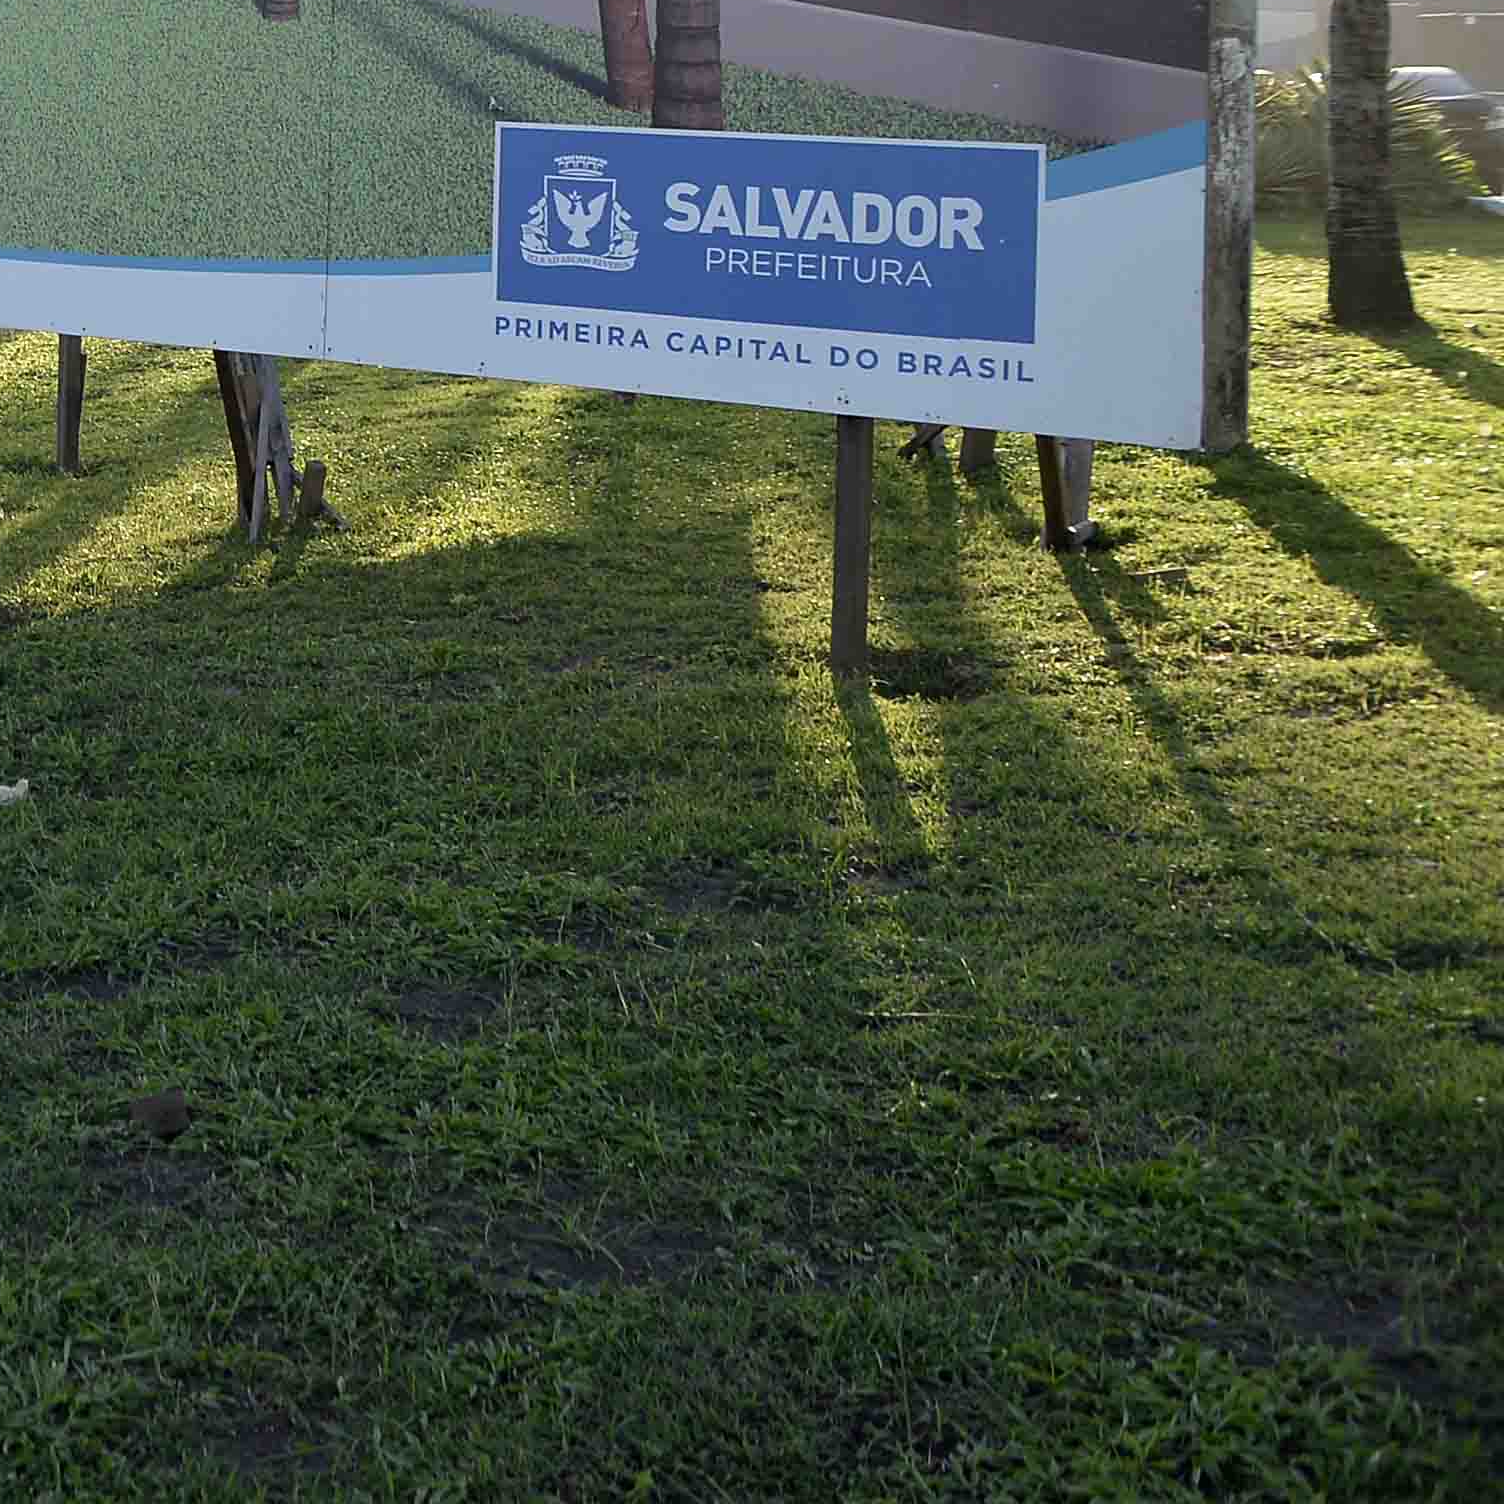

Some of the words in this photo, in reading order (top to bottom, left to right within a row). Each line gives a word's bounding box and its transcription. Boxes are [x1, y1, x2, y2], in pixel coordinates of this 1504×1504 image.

[663, 181, 985, 251] SALVADOR
[706, 247, 933, 288] PREFEITURA
[495, 316, 650, 350] PRIMEIRA
[666, 332, 812, 366] CAPITAL
[829, 346, 879, 371] DO
[898, 351, 1035, 383] BRASIL
